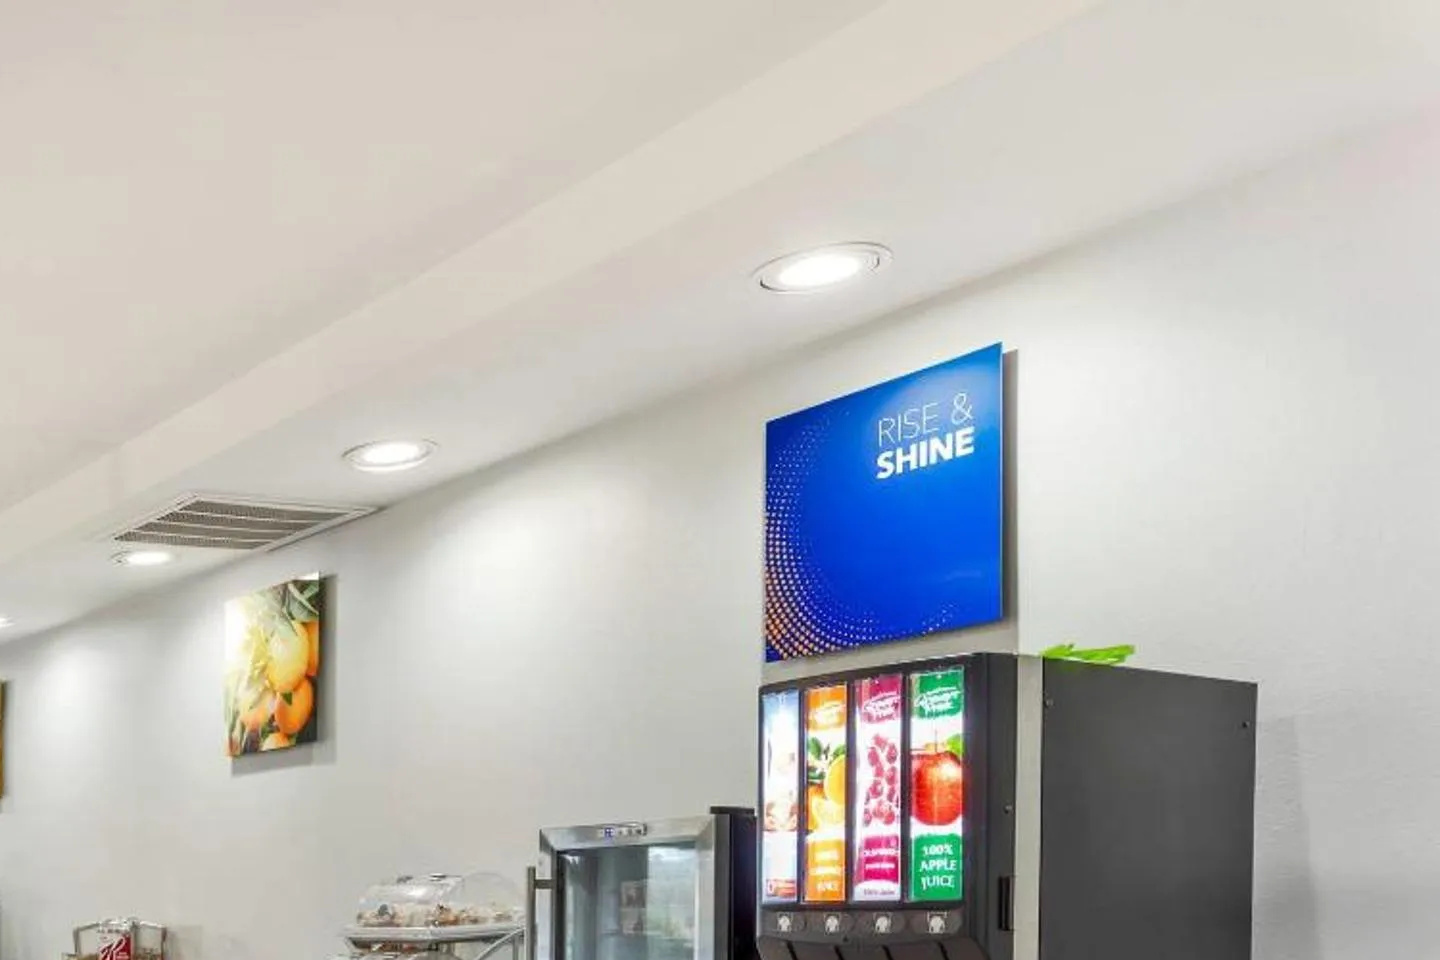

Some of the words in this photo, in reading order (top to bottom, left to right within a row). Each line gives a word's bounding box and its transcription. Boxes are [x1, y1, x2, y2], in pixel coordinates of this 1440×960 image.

[878, 402, 940, 447] RISE
[950, 392, 973, 425] &
[876, 426, 975, 479] SHINE
[922, 843, 954, 856] 100%
[920, 858, 958, 871] APPLE
[921, 874, 955, 891] JUICE
